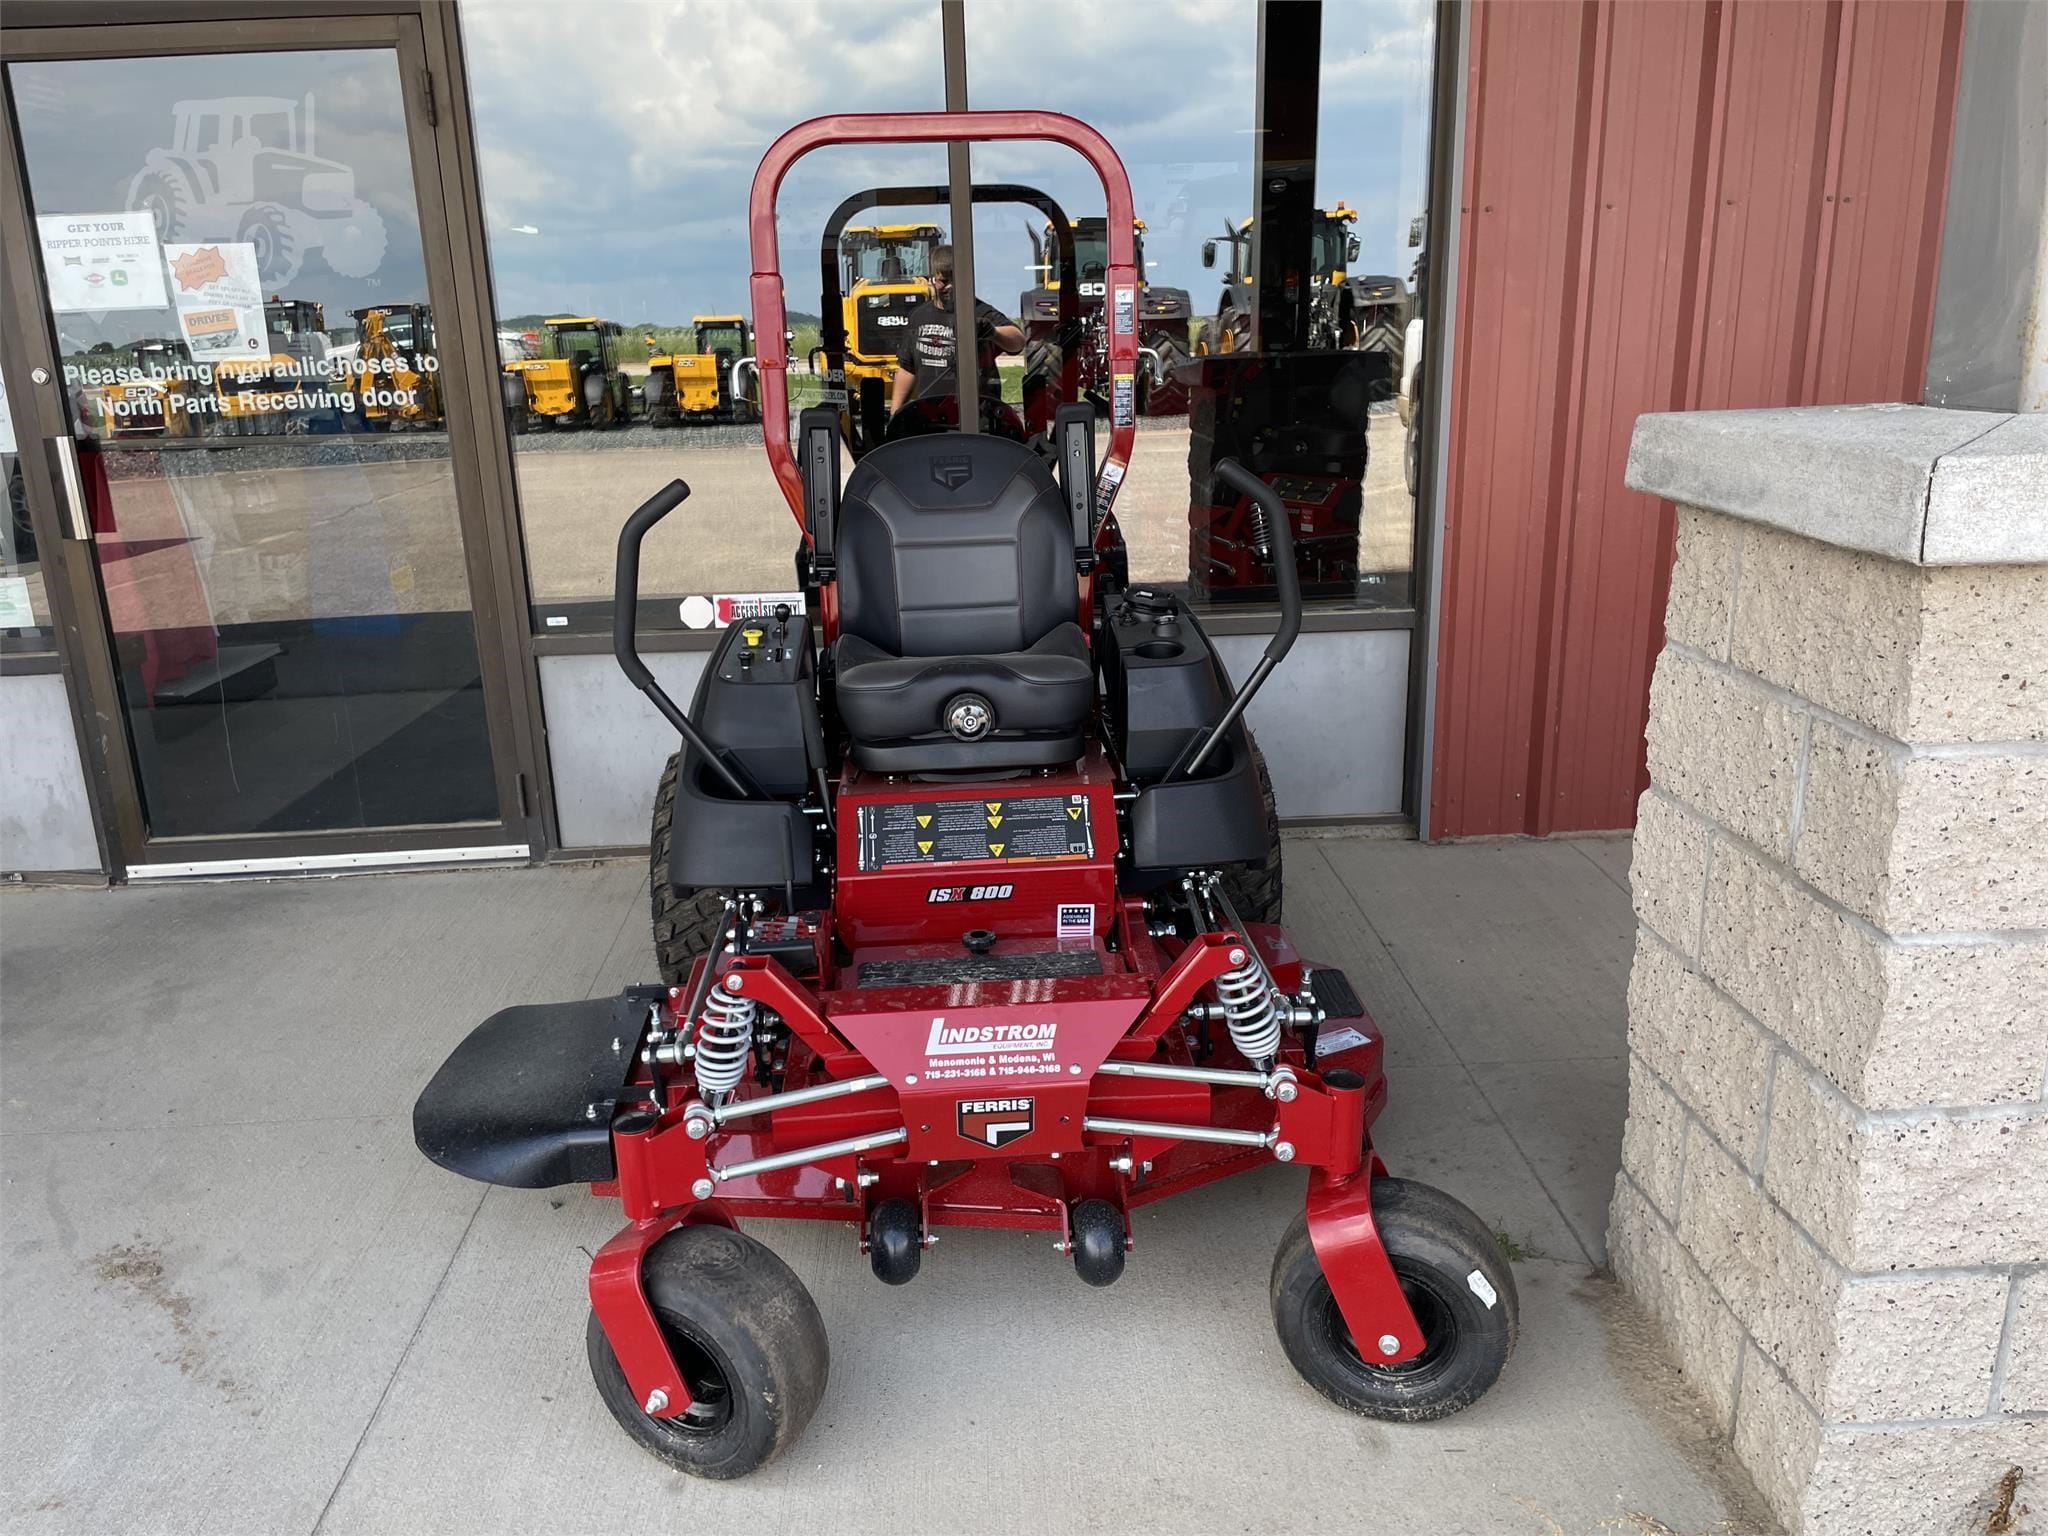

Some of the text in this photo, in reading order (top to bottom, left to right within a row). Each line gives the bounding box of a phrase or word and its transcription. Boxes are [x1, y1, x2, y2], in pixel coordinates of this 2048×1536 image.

[67, 222, 125, 233] GET YOUR
[47, 235, 151, 249] RIPPER POINTS HERE
[189, 313, 229, 326] DRIVES
[63, 353, 439, 386] Please bring hydraulic hoses to
[97, 387, 418, 417] North Parts Receiving door
[731, 605, 759, 618] ACCESS
[928, 885, 1014, 902] ISX 800
[925, 1017, 1057, 1055] LINDSTROM
[929, 1053, 1056, 1067] Menomonie & Modena, WI
[989, 1067, 997, 1076] &
[962, 1099, 1030, 1113] FERRIS
